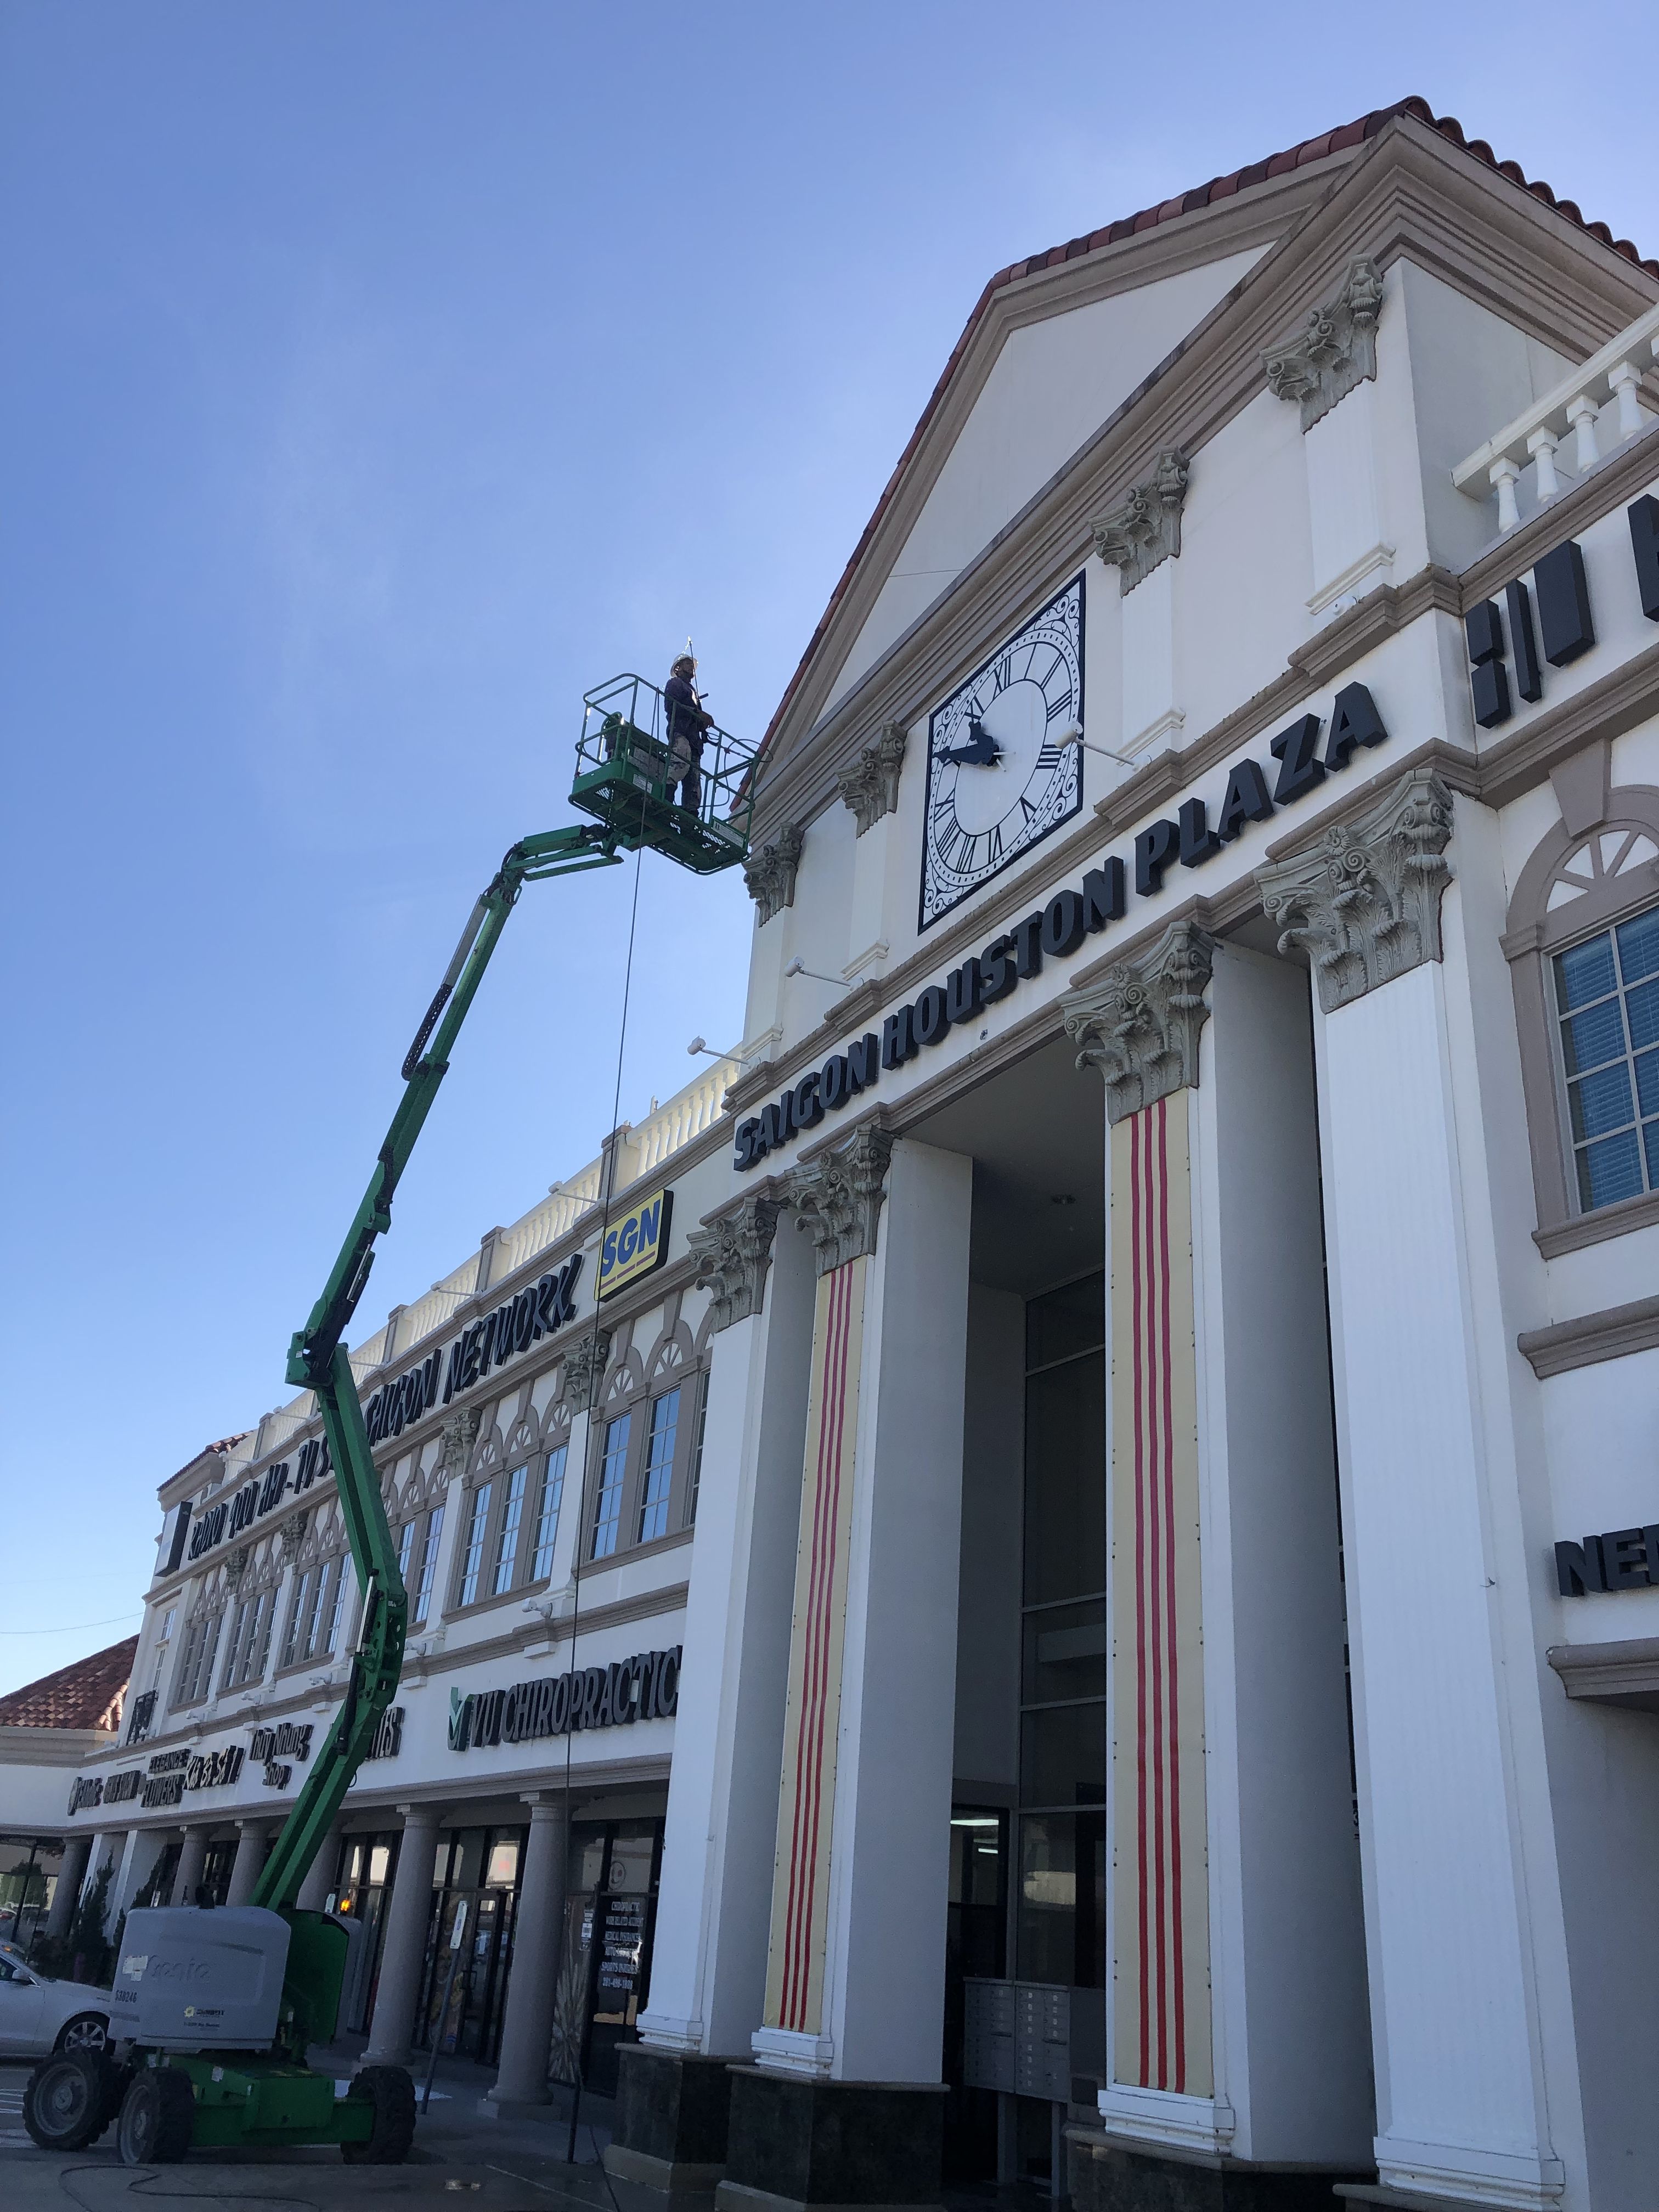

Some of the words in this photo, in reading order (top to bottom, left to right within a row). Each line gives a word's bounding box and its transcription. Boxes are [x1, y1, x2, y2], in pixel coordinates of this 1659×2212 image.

[733, 1032, 878, 1172] SAIGON
[882, 856, 1124, 1071] HOUSTON
[1135, 681, 1388, 898] PLAZA
[601, 1198, 661, 1277] SGN
[364, 1348, 442, 1447] SAIGON
[442, 1254, 583, 1404] NETWORK
[470, 1690, 506, 1748] VU
[500, 1645, 682, 1743] CHIROPRACTIC
